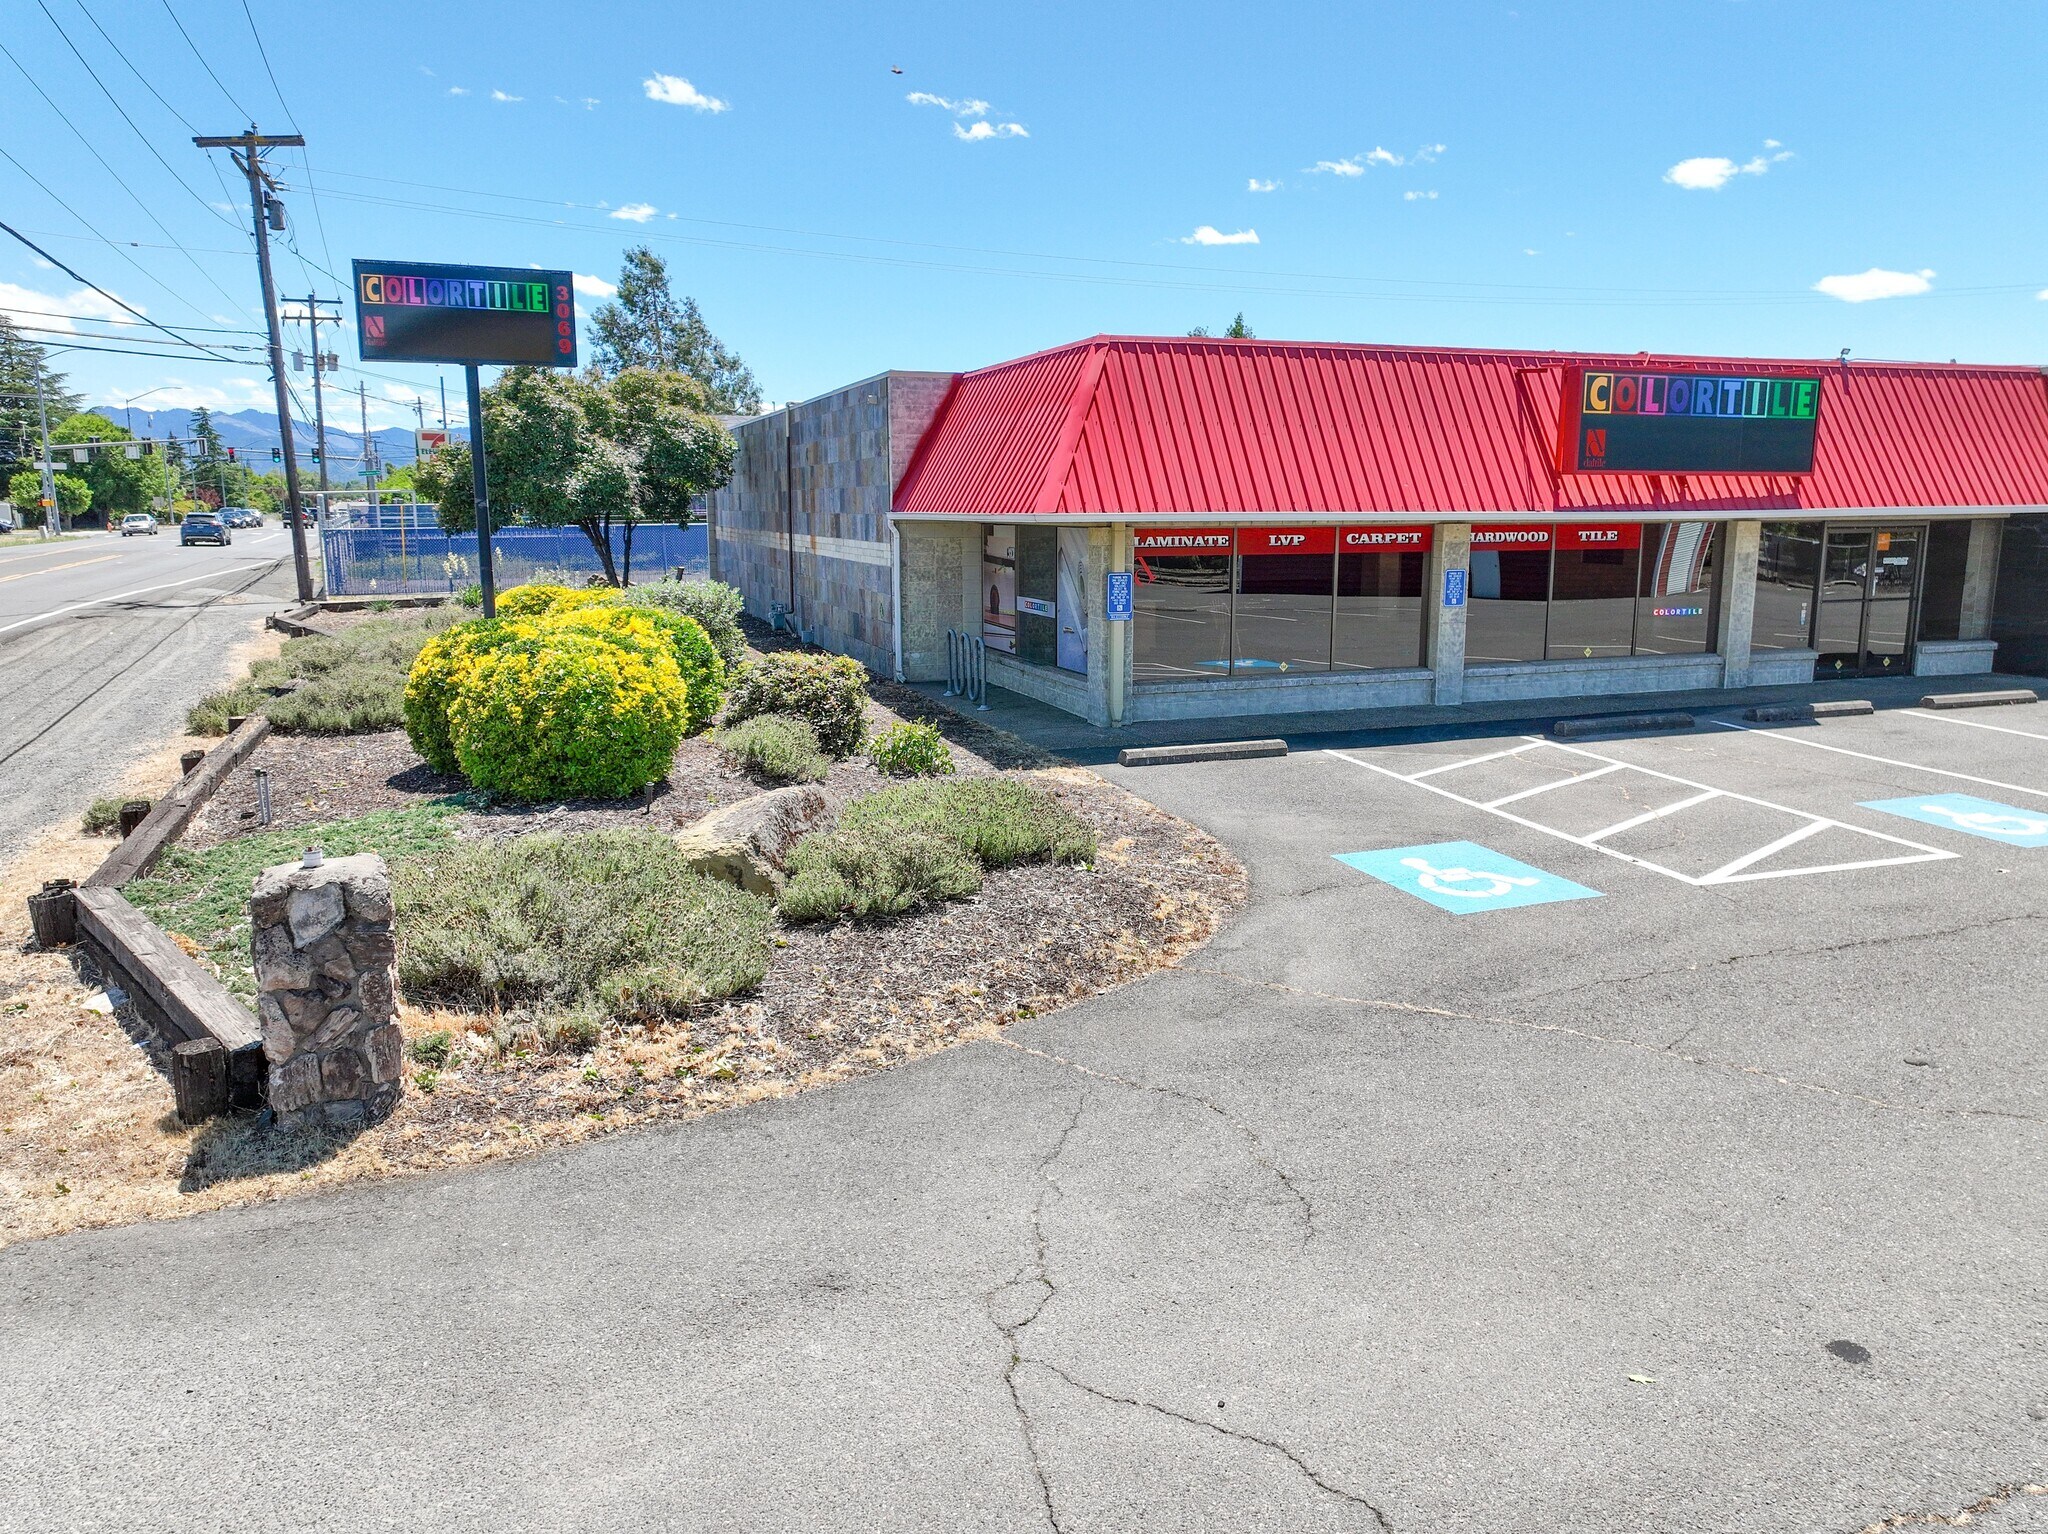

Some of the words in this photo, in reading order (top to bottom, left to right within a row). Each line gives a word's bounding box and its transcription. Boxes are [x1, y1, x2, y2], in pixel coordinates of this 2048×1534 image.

[364, 276, 546, 311] COLORTILE
[556, 285, 572, 354] 3069
[1587, 376, 1814, 417] COLORTILE
[1133, 535, 1230, 548] LAMINATE
[1268, 534, 1306, 546] LVP
[1346, 532, 1422, 545] CARPET
[1578, 530, 1618, 542] TILE
[1653, 608, 1703, 616] COLORTILE
